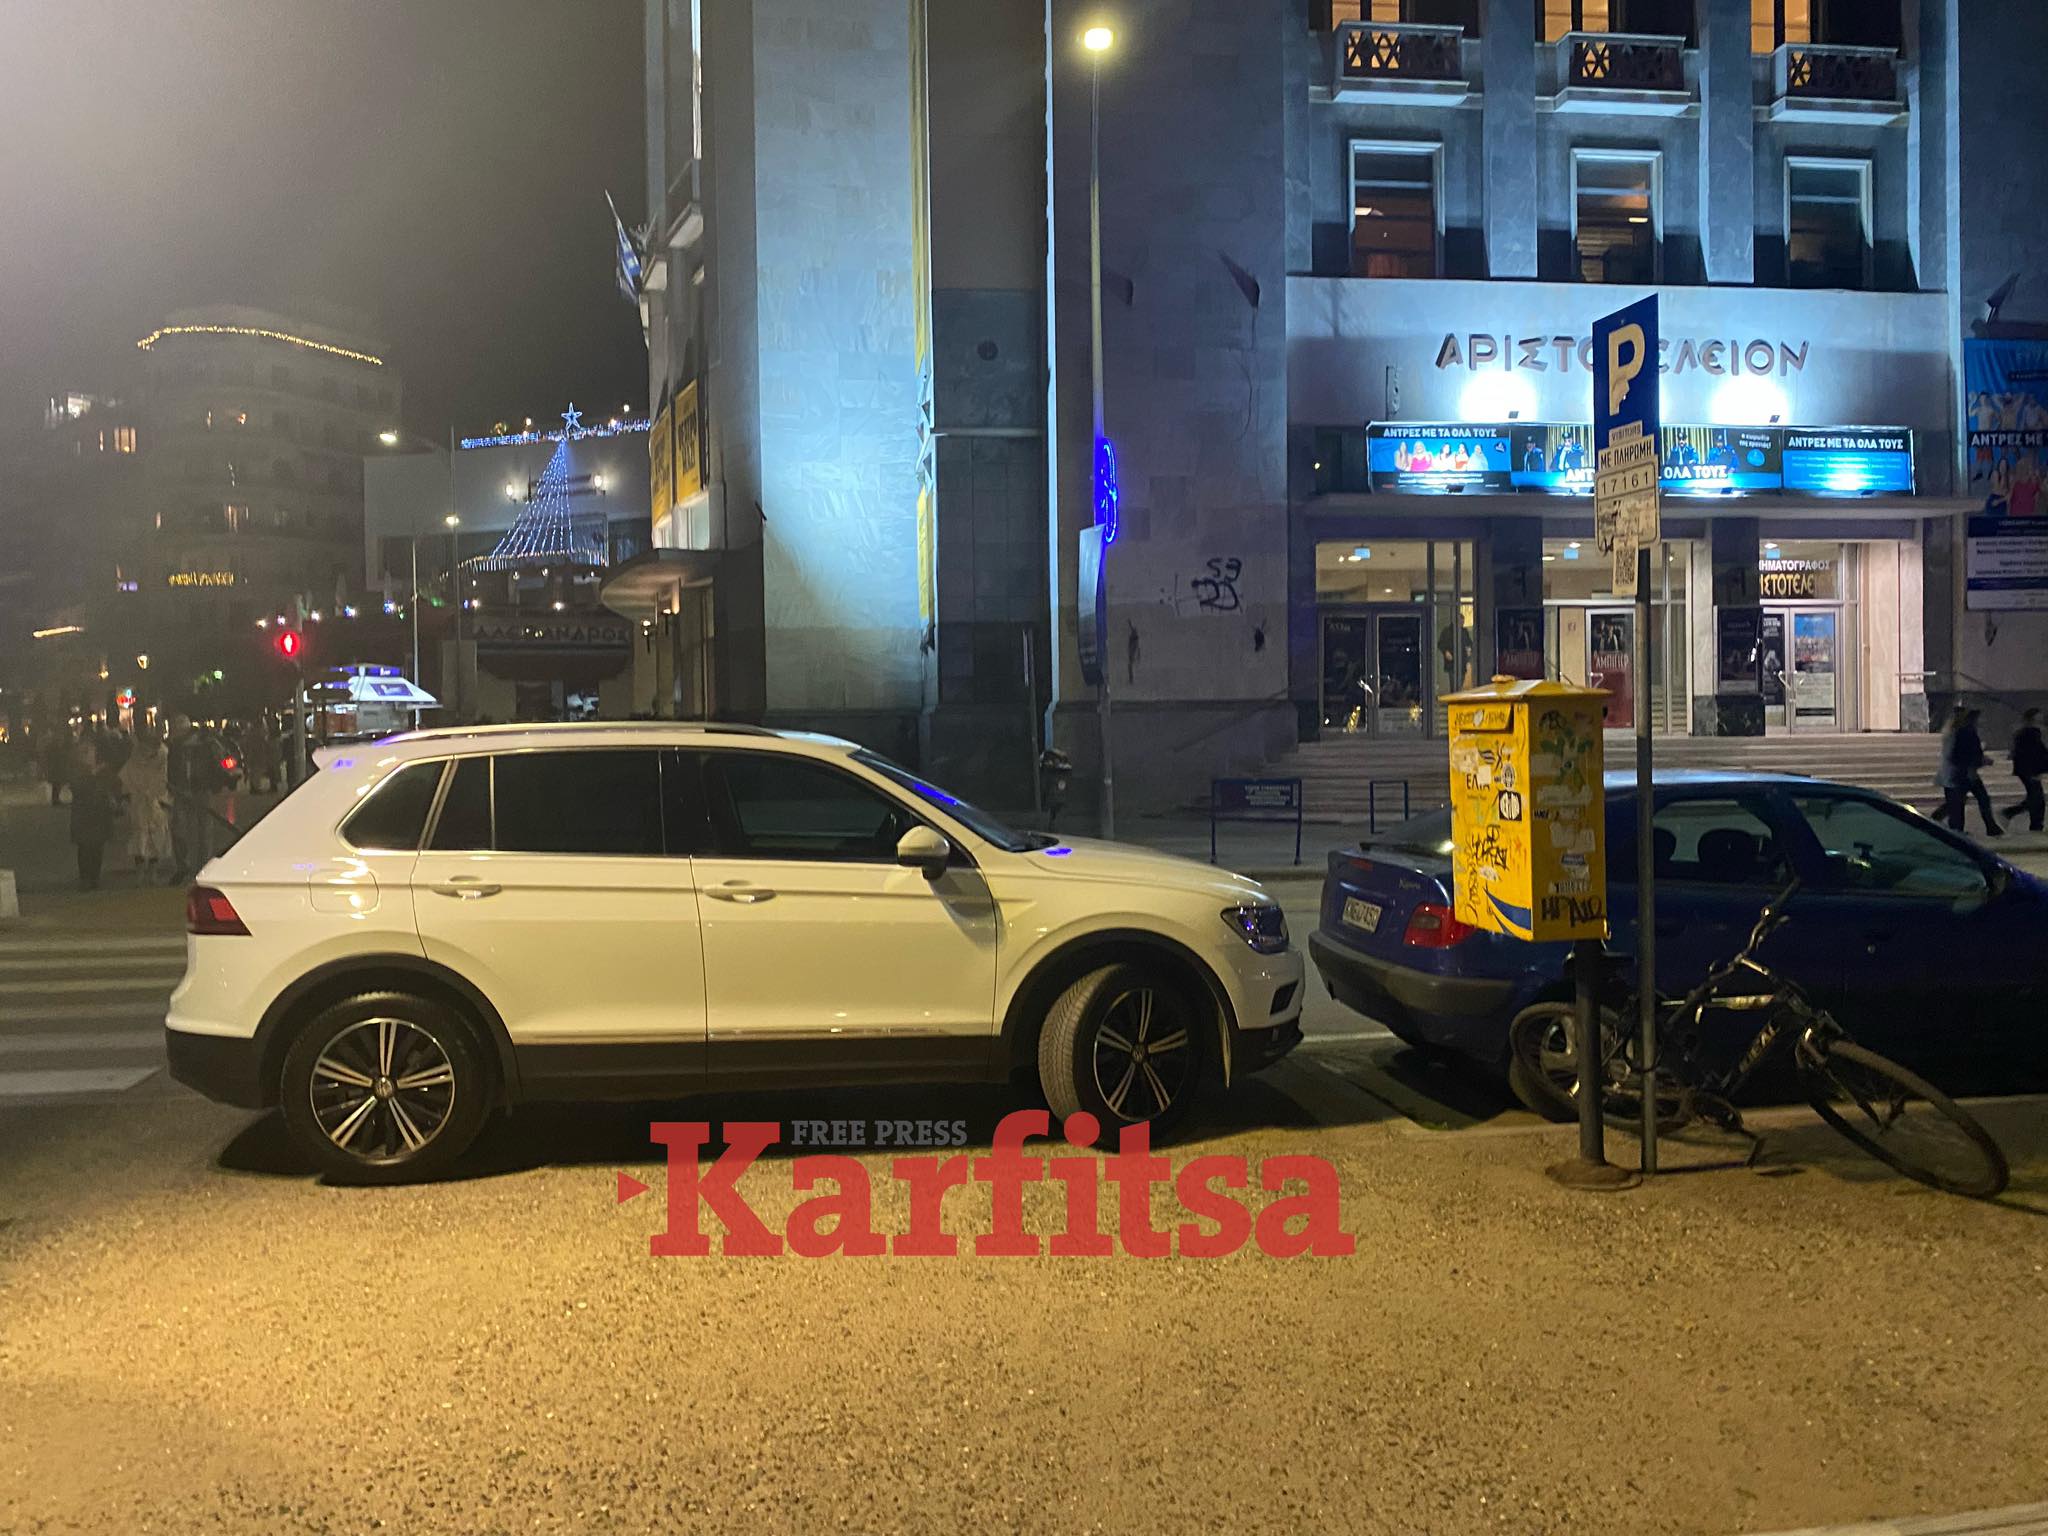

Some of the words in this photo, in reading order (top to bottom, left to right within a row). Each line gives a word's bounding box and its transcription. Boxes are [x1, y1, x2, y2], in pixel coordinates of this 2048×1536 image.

[1435, 332, 1810, 376] ΑΡΙΣΤΟΕΛΕΙΟΝ
[1608, 323, 1645, 416] P
[1383, 428, 1421, 437] ΑΝΤΡΕΣ
[1422, 428, 1437, 437] ΜΕ
[1438, 428, 1451, 437] ΤΑ
[1452, 428, 1472, 438] ΟΛΑ
[1473, 428, 1497, 437] ΤΟΥΣ
[1971, 433, 2022, 446] ΑΝΤΡΕΣ
[2024, 433, 2043, 446] ΜΕ
[1788, 437, 1825, 448] ΑΝΤΡΕΣ
[1827, 437, 1842, 448] ΜΕ
[1843, 438, 1856, 449] ΤΑ
[1857, 439, 1878, 449] ΟΛΑ
[1879, 439, 1903, 450] ΤΟΥΣ
[1601, 452, 1612, 470] ΜΕ
[1565, 468, 1595, 482] ΑΝΤ
[1663, 466, 1691, 479] ΟΛΑ
[1693, 465, 1728, 479] ΤΟΥΣ
[1601, 471, 1648, 495] 17161
